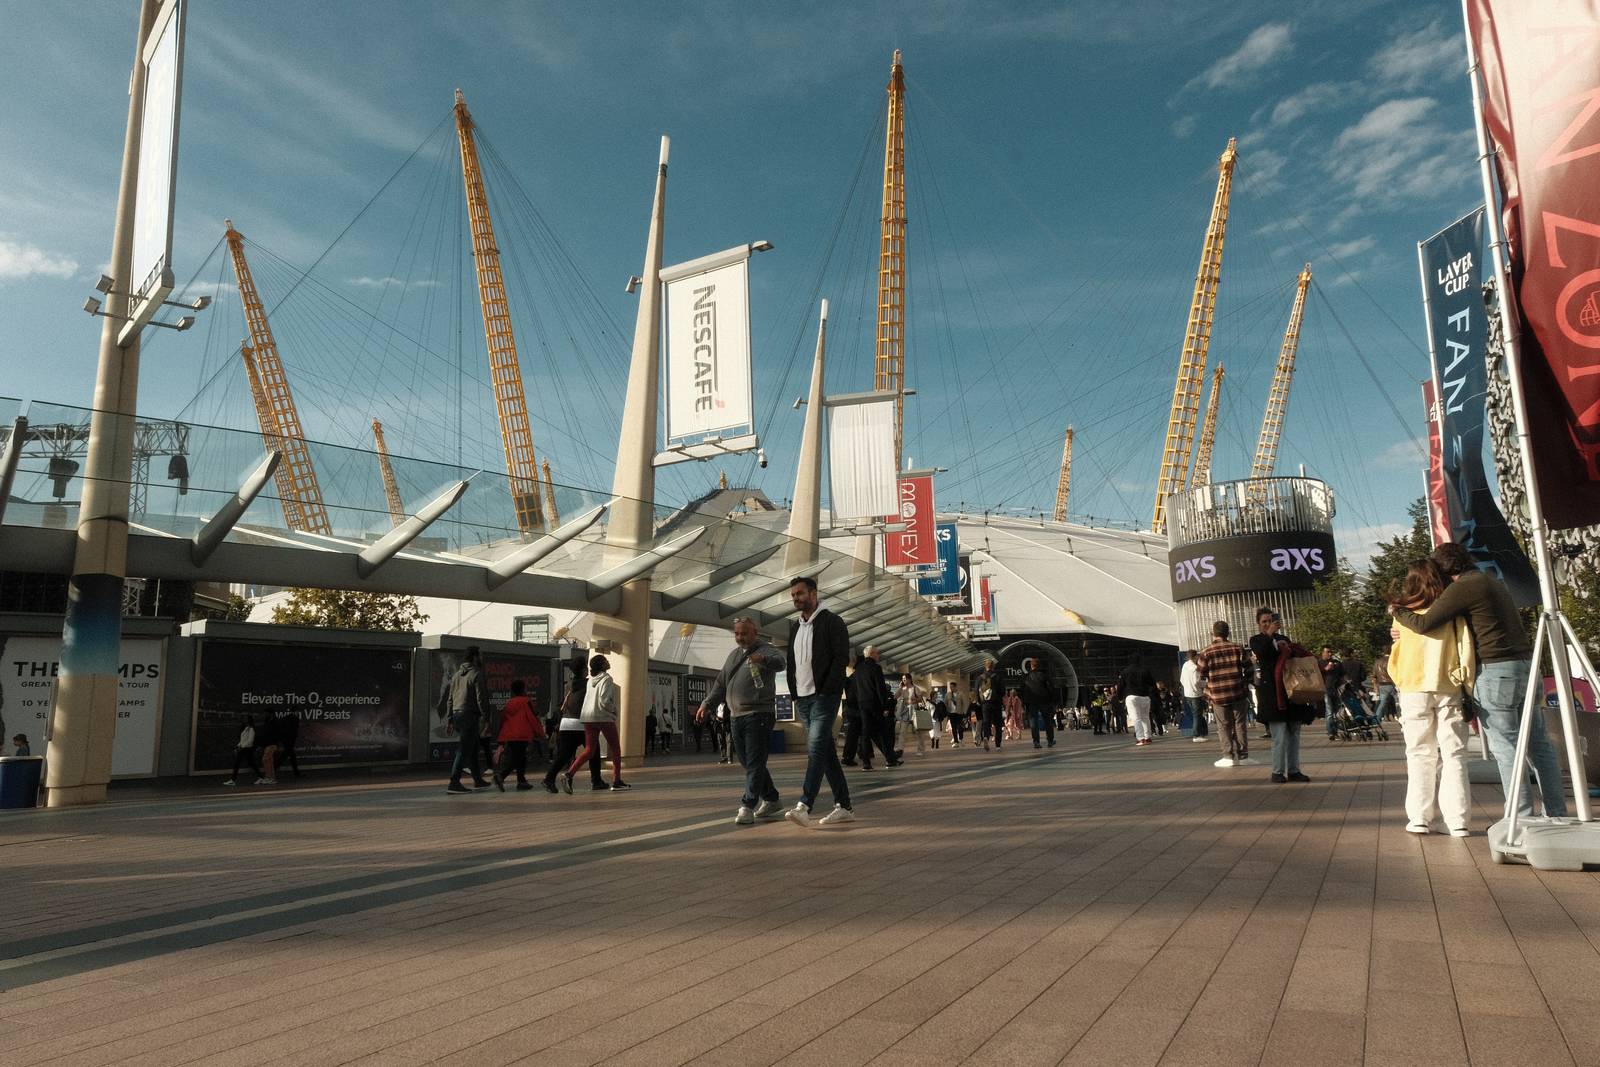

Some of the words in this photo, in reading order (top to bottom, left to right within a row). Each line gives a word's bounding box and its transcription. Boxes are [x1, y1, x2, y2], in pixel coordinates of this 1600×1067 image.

[1438, 252, 1473, 285] LAVER
[1442, 306, 1470, 416] FAN
[13, 661, 59, 677] THE
[117, 663, 159, 678] MPS
[241, 692, 284, 705] Elevate
[285, 693, 306, 705] The
[325, 693, 381, 707] experience
[304, 709, 323, 720] VIP
[324, 710, 351, 720] seats
